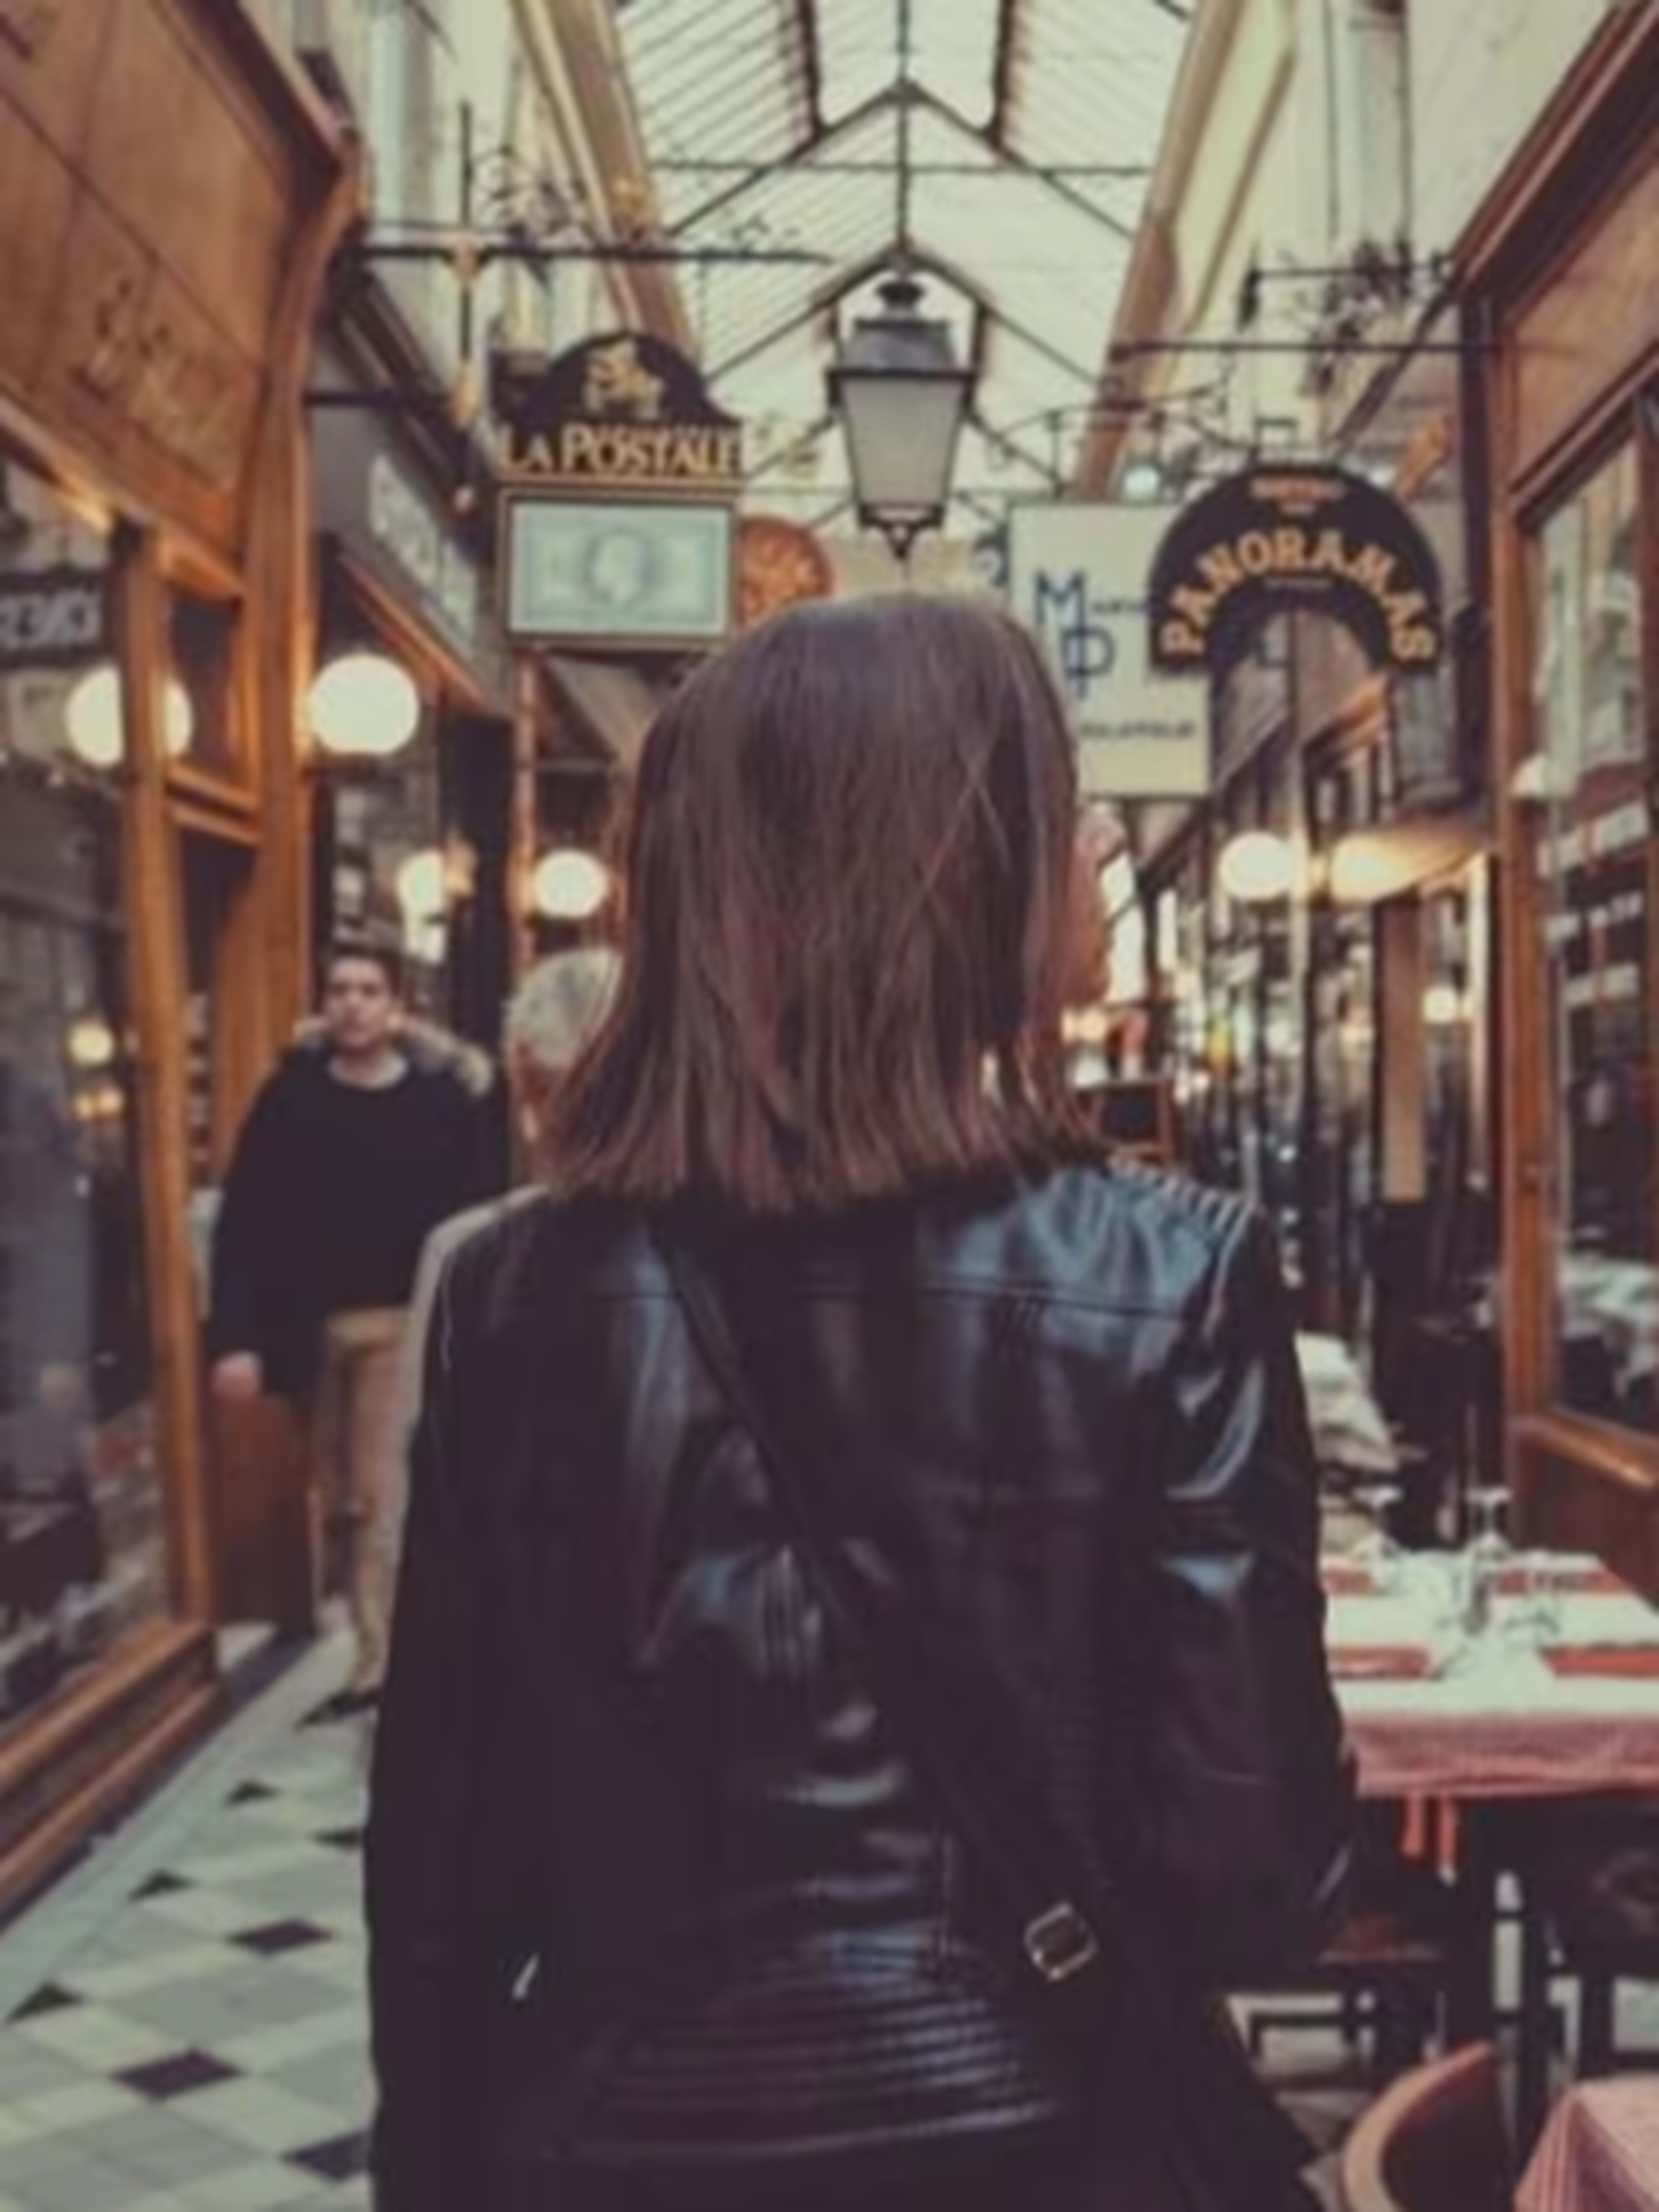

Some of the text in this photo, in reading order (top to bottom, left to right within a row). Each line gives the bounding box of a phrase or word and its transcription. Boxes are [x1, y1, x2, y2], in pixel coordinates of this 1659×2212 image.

[498, 422, 739, 474] LA POSTALE
[1158, 529, 1437, 662] PANORAMAS
